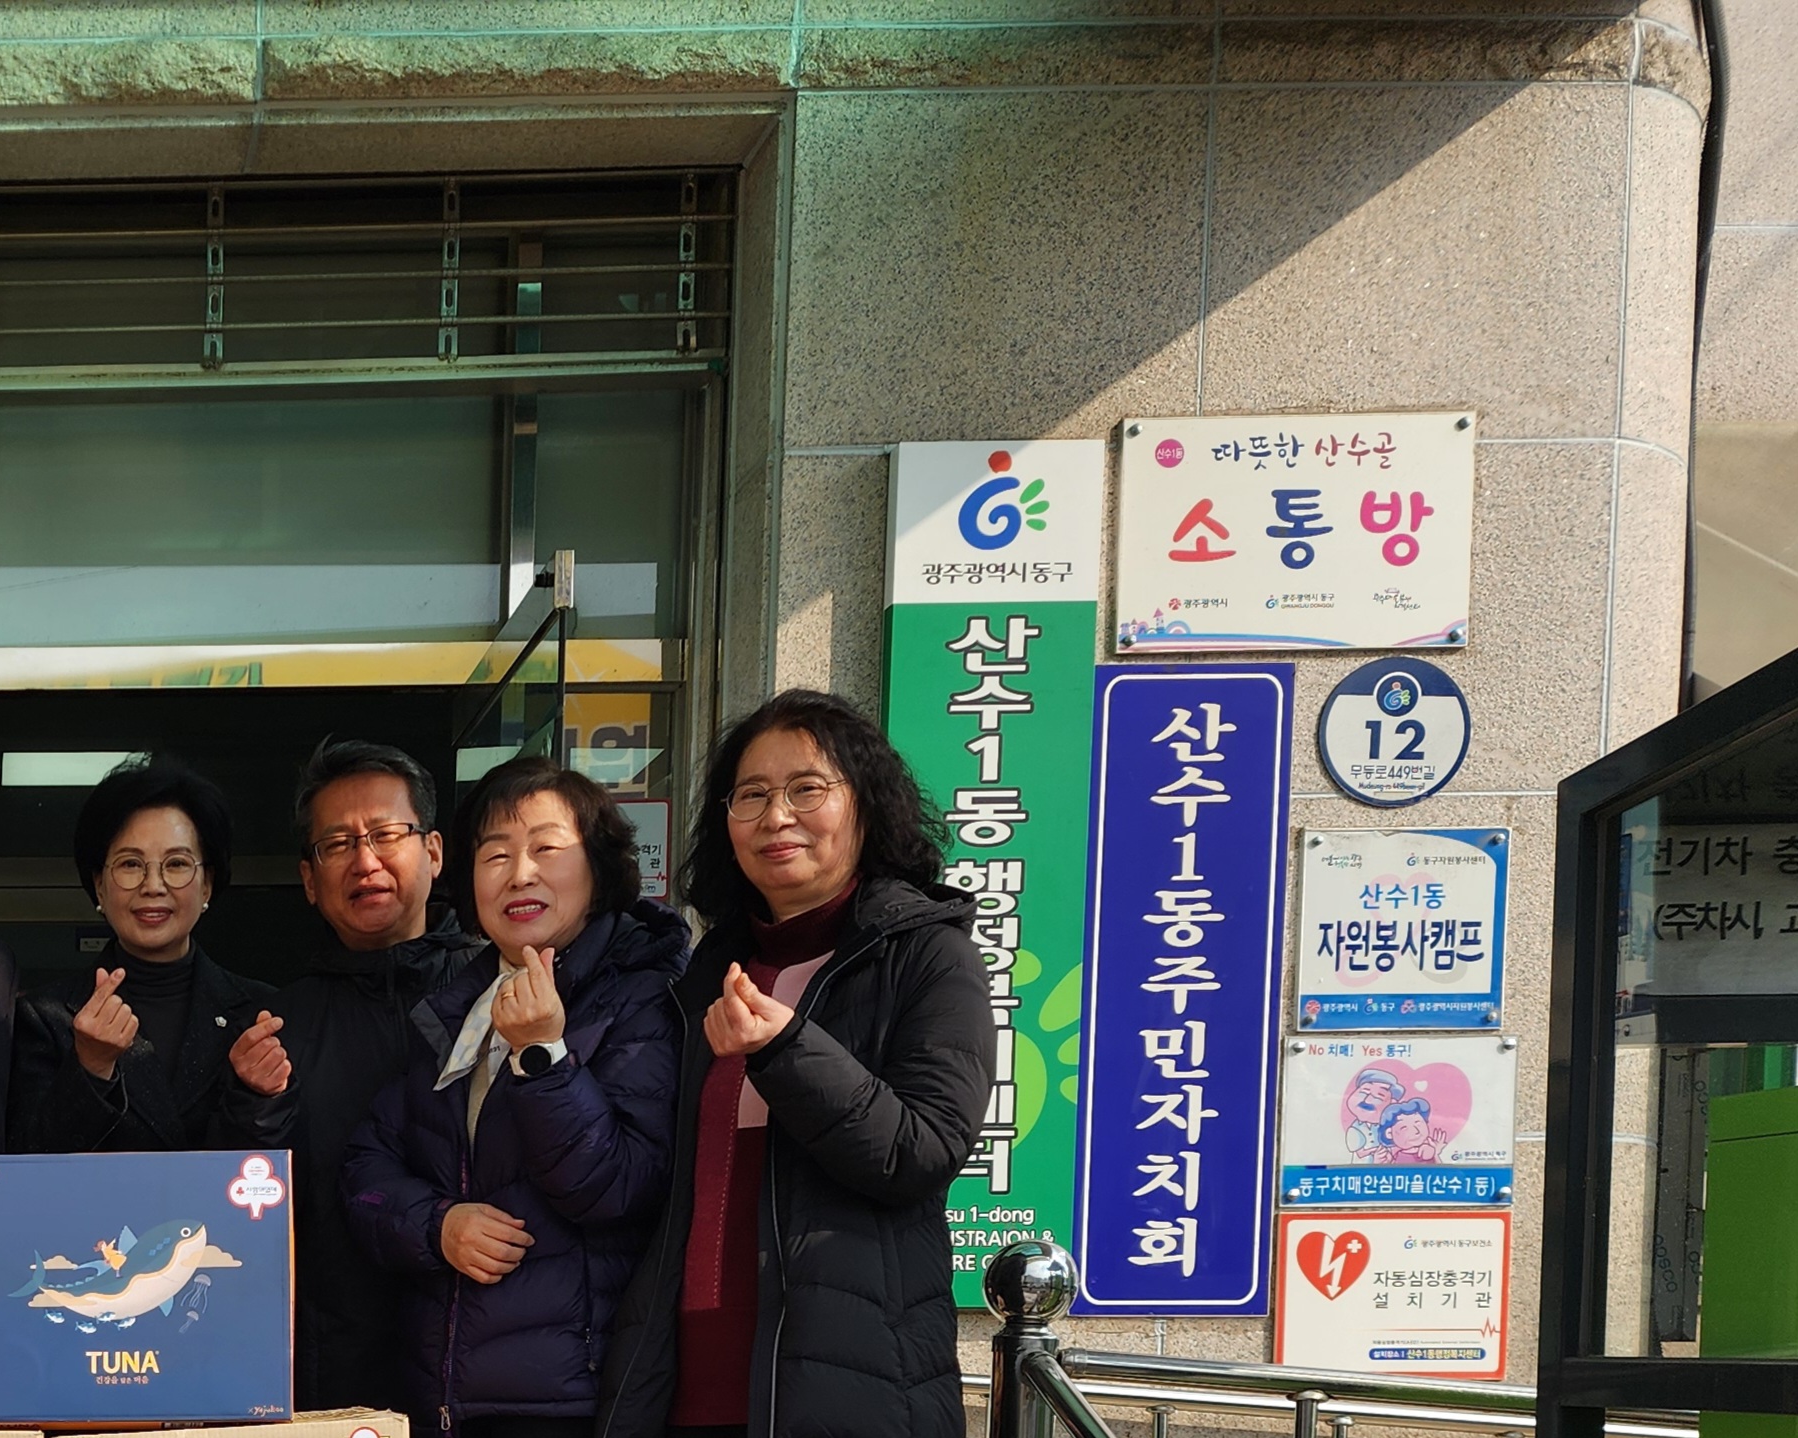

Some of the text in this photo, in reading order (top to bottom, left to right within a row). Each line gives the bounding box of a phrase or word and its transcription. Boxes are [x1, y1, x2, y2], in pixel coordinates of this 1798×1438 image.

[1156, 432, 1397, 471] 산수1동 따뜻한 산수골
[1183, 598, 1229, 608] 광주광역시
[1365, 719, 1426, 761] 12
[1350, 765, 1436, 780] 무등로449번길
[1423, 855, 1486, 866] 동구자원봉사센터
[1636, 835, 1754, 877] 전기차
[1359, 883, 1446, 910] 산수1동
[1317, 919, 1485, 973] 자원봉사캠프
[1323, 1003, 1359, 1013] 광주광역시
[1308, 1044, 1412, 1057] No 치매! Yes 동구!
[969, 1205, 1035, 1225] 1-dong
[1373, 1270, 1493, 1287] 자동심장충격기
[85, 1350, 160, 1375] TUNA
